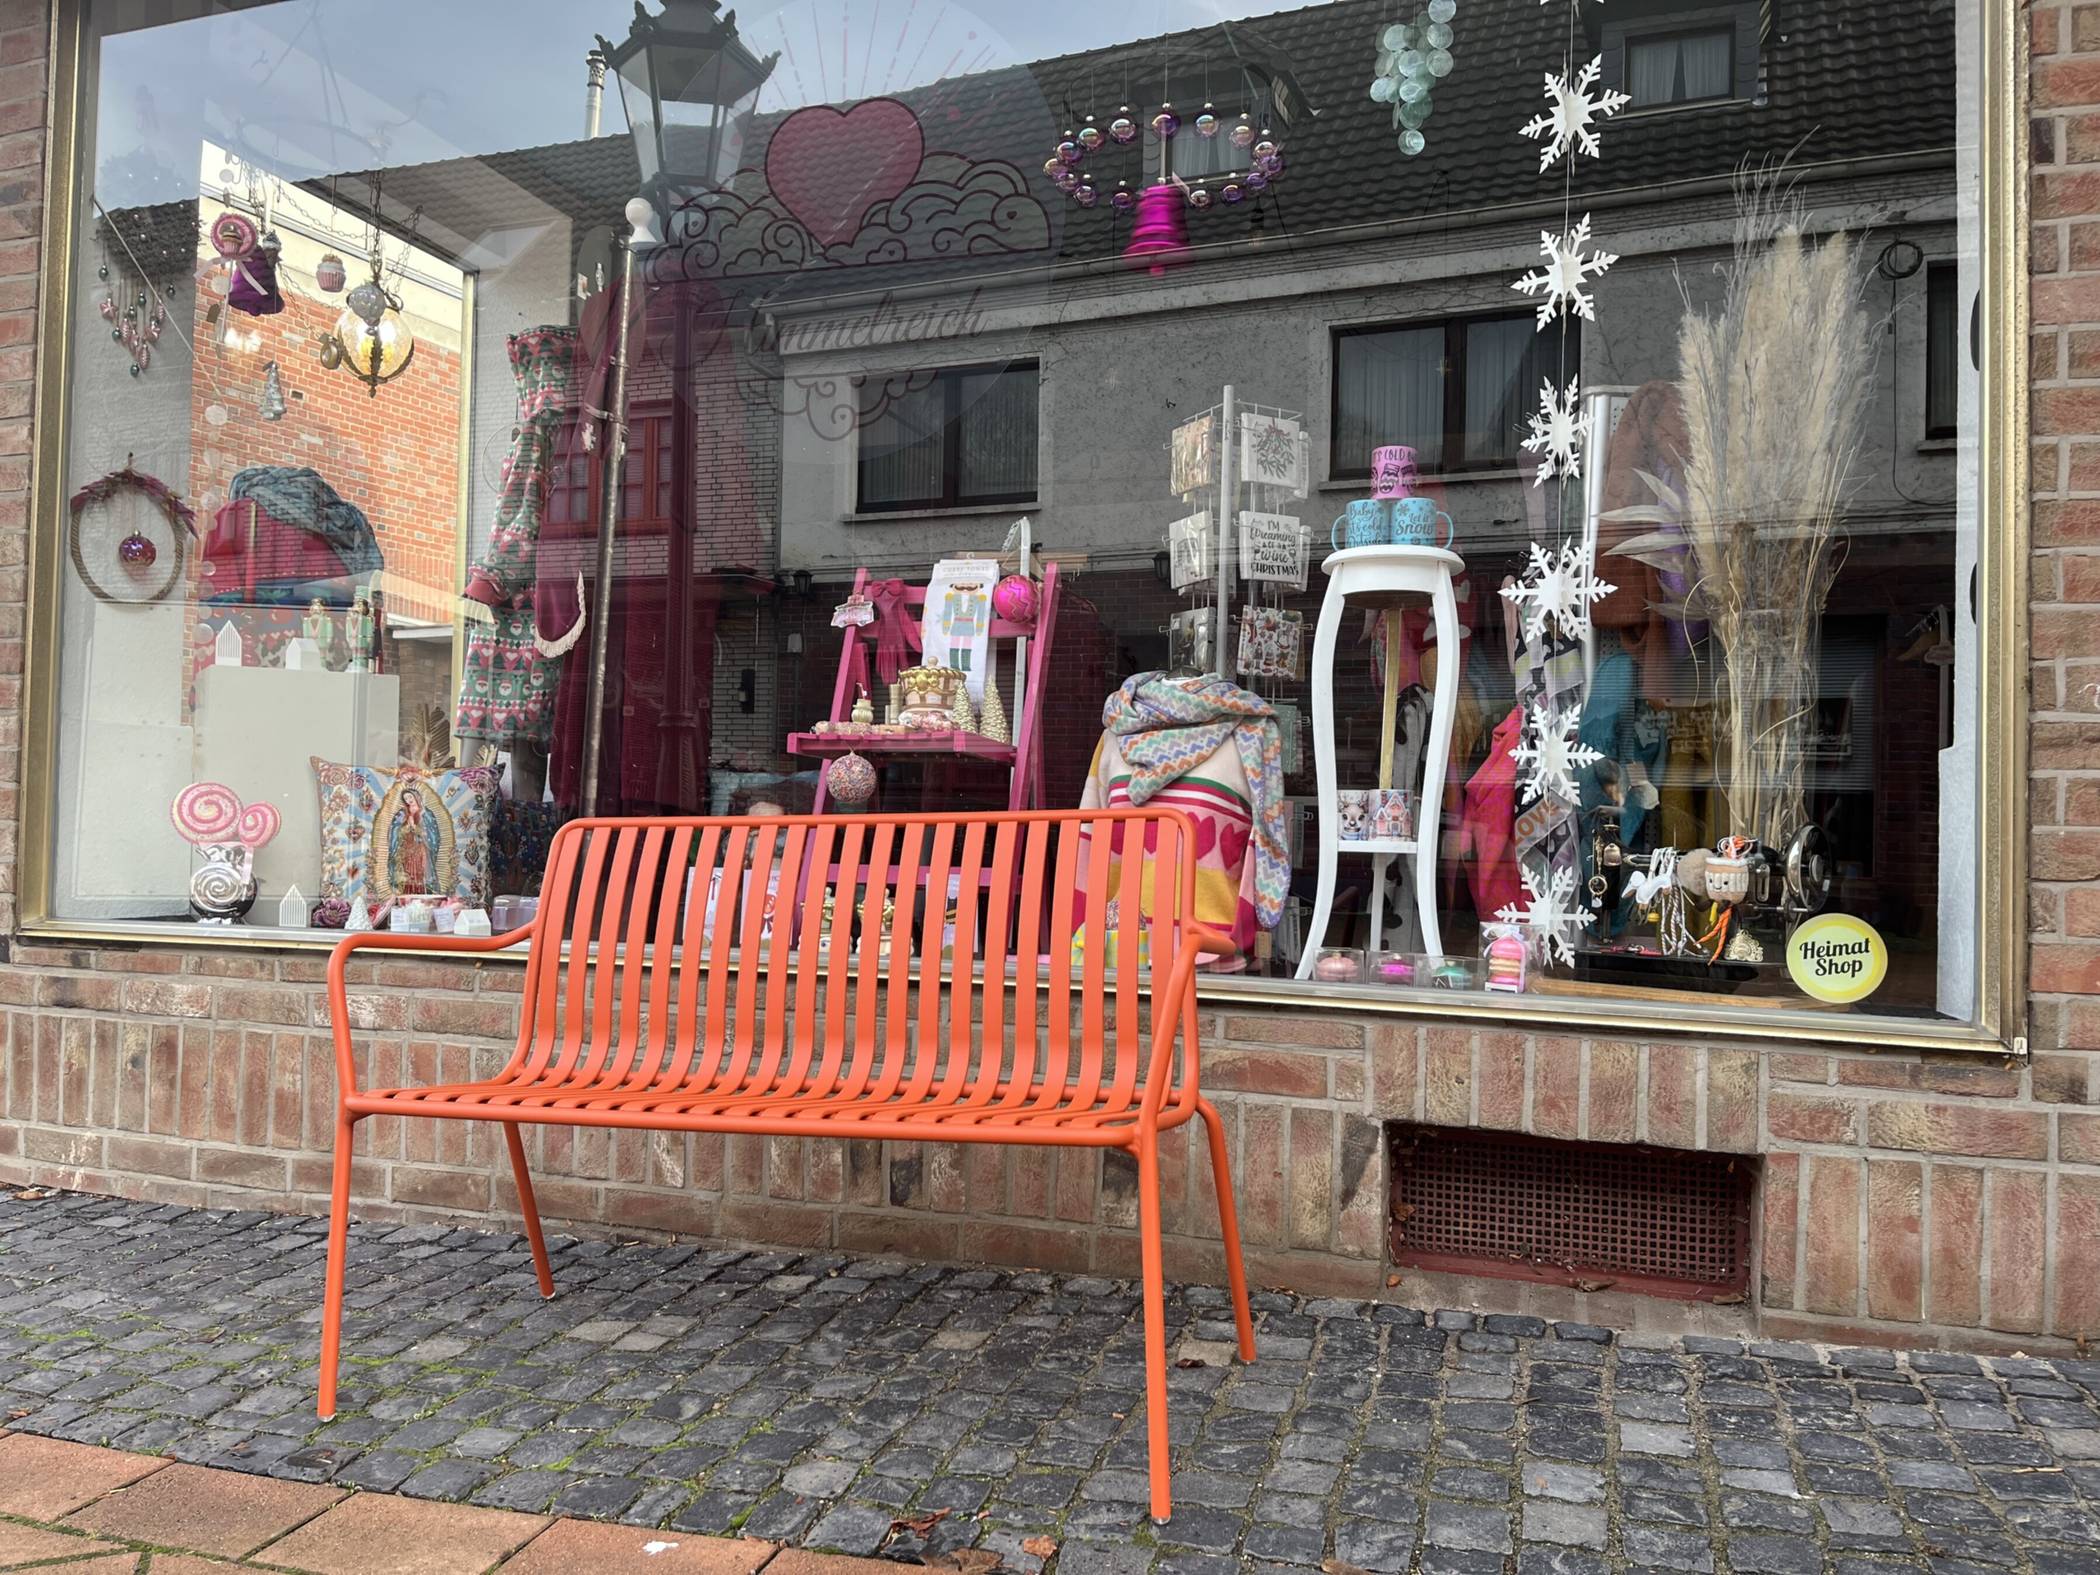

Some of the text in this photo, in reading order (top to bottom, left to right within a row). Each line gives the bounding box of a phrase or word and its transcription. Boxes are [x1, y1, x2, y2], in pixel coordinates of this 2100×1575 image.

[661, 284, 990, 370] Himmelreich
[1395, 519, 1433, 536] Snow
[1250, 562, 1300, 576] CHRISTMAS
[1799, 937, 1872, 960] Heimat
[1815, 957, 1864, 978] Shop
